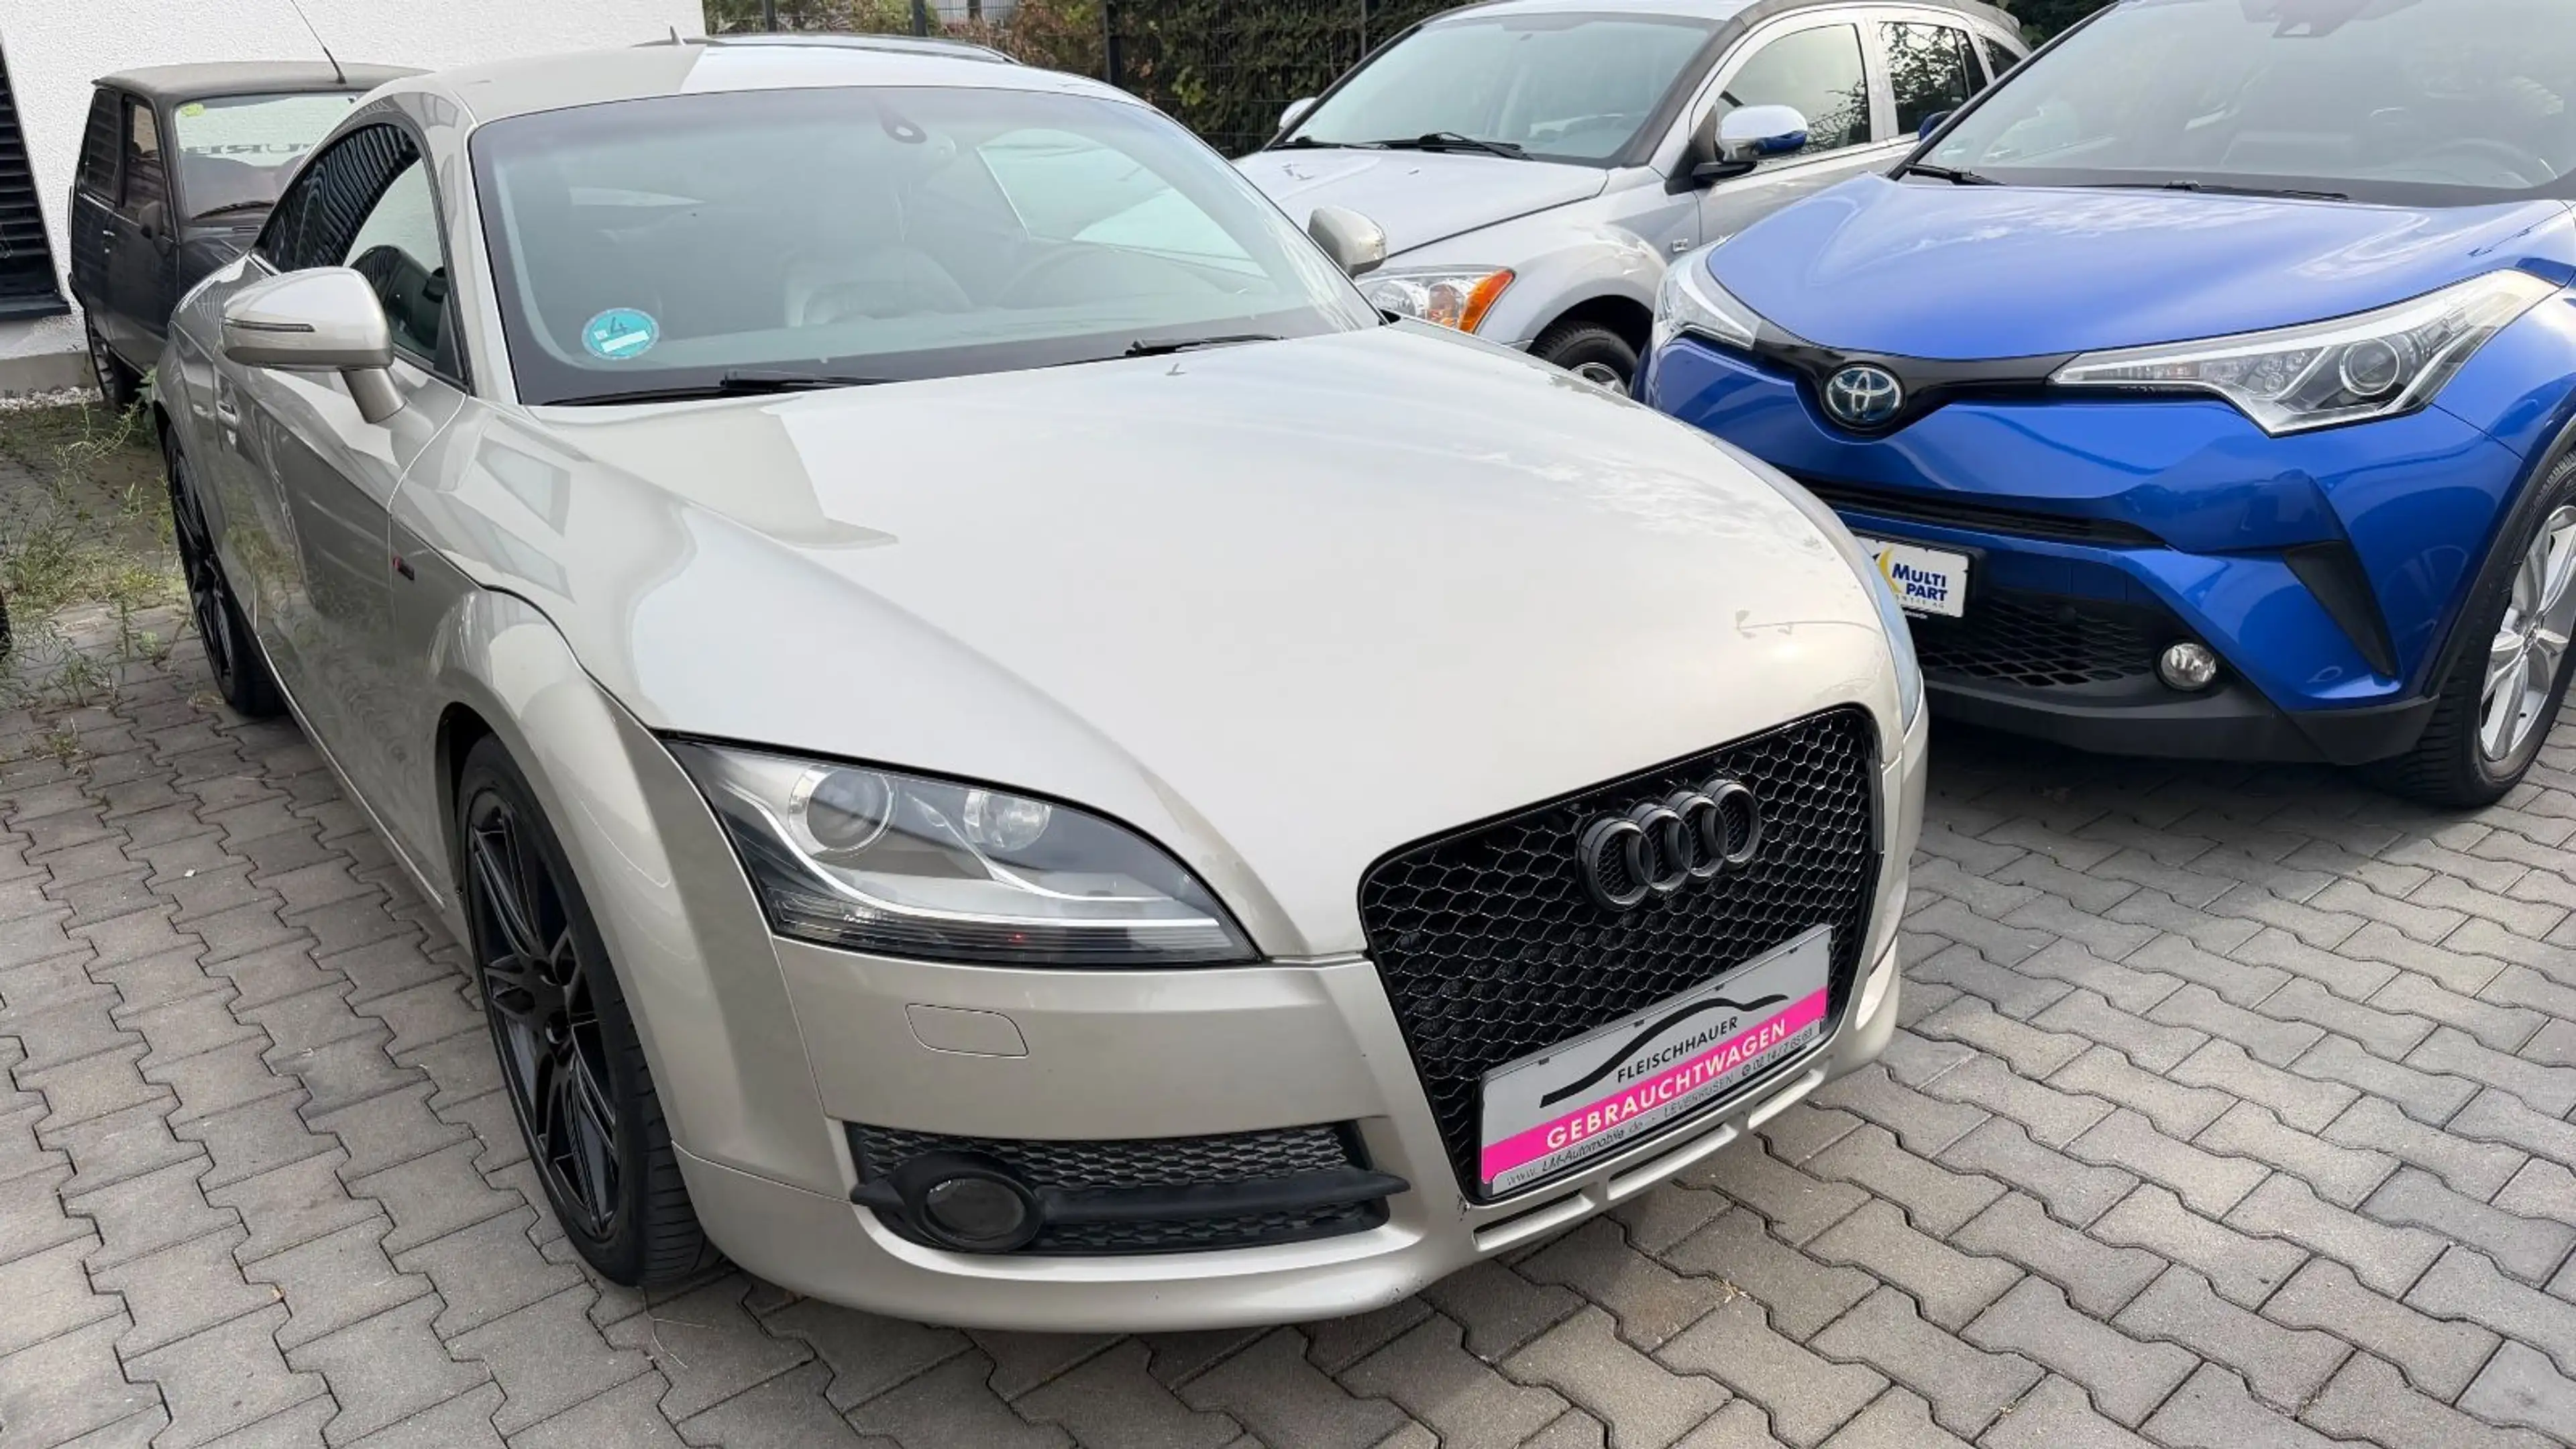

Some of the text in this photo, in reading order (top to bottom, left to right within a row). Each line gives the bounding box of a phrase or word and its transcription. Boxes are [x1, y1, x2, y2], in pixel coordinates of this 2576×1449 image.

[1892, 563, 1947, 588] MULTI
[1906, 582, 1947, 602] PART
[1617, 1016, 1739, 1083] FLEISCHHAUER
[1547, 1018, 1786, 1148] GEBRAUCHTWAGEN
